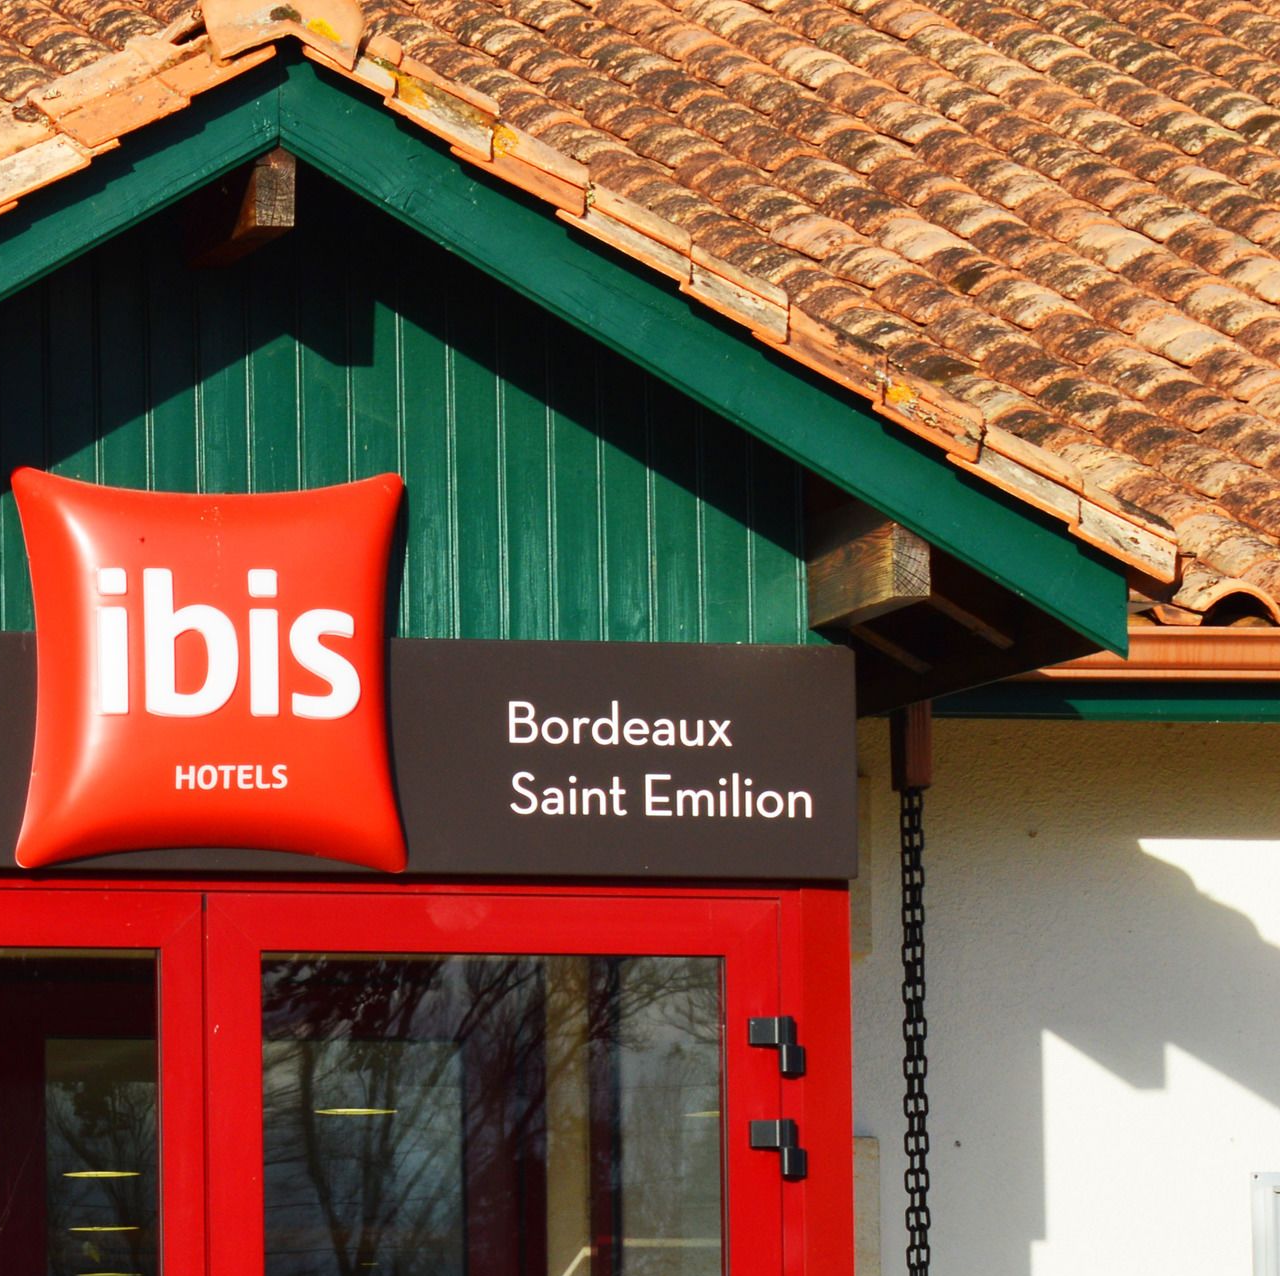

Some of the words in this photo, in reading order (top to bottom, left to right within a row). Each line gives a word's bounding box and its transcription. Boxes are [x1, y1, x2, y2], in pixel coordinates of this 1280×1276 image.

[96, 568, 361, 718] ibis
[508, 700, 733, 747] Bordeaux
[175, 763, 289, 790] HOTELS
[510, 771, 628, 817] Saint
[644, 772, 813, 819] Emilion
